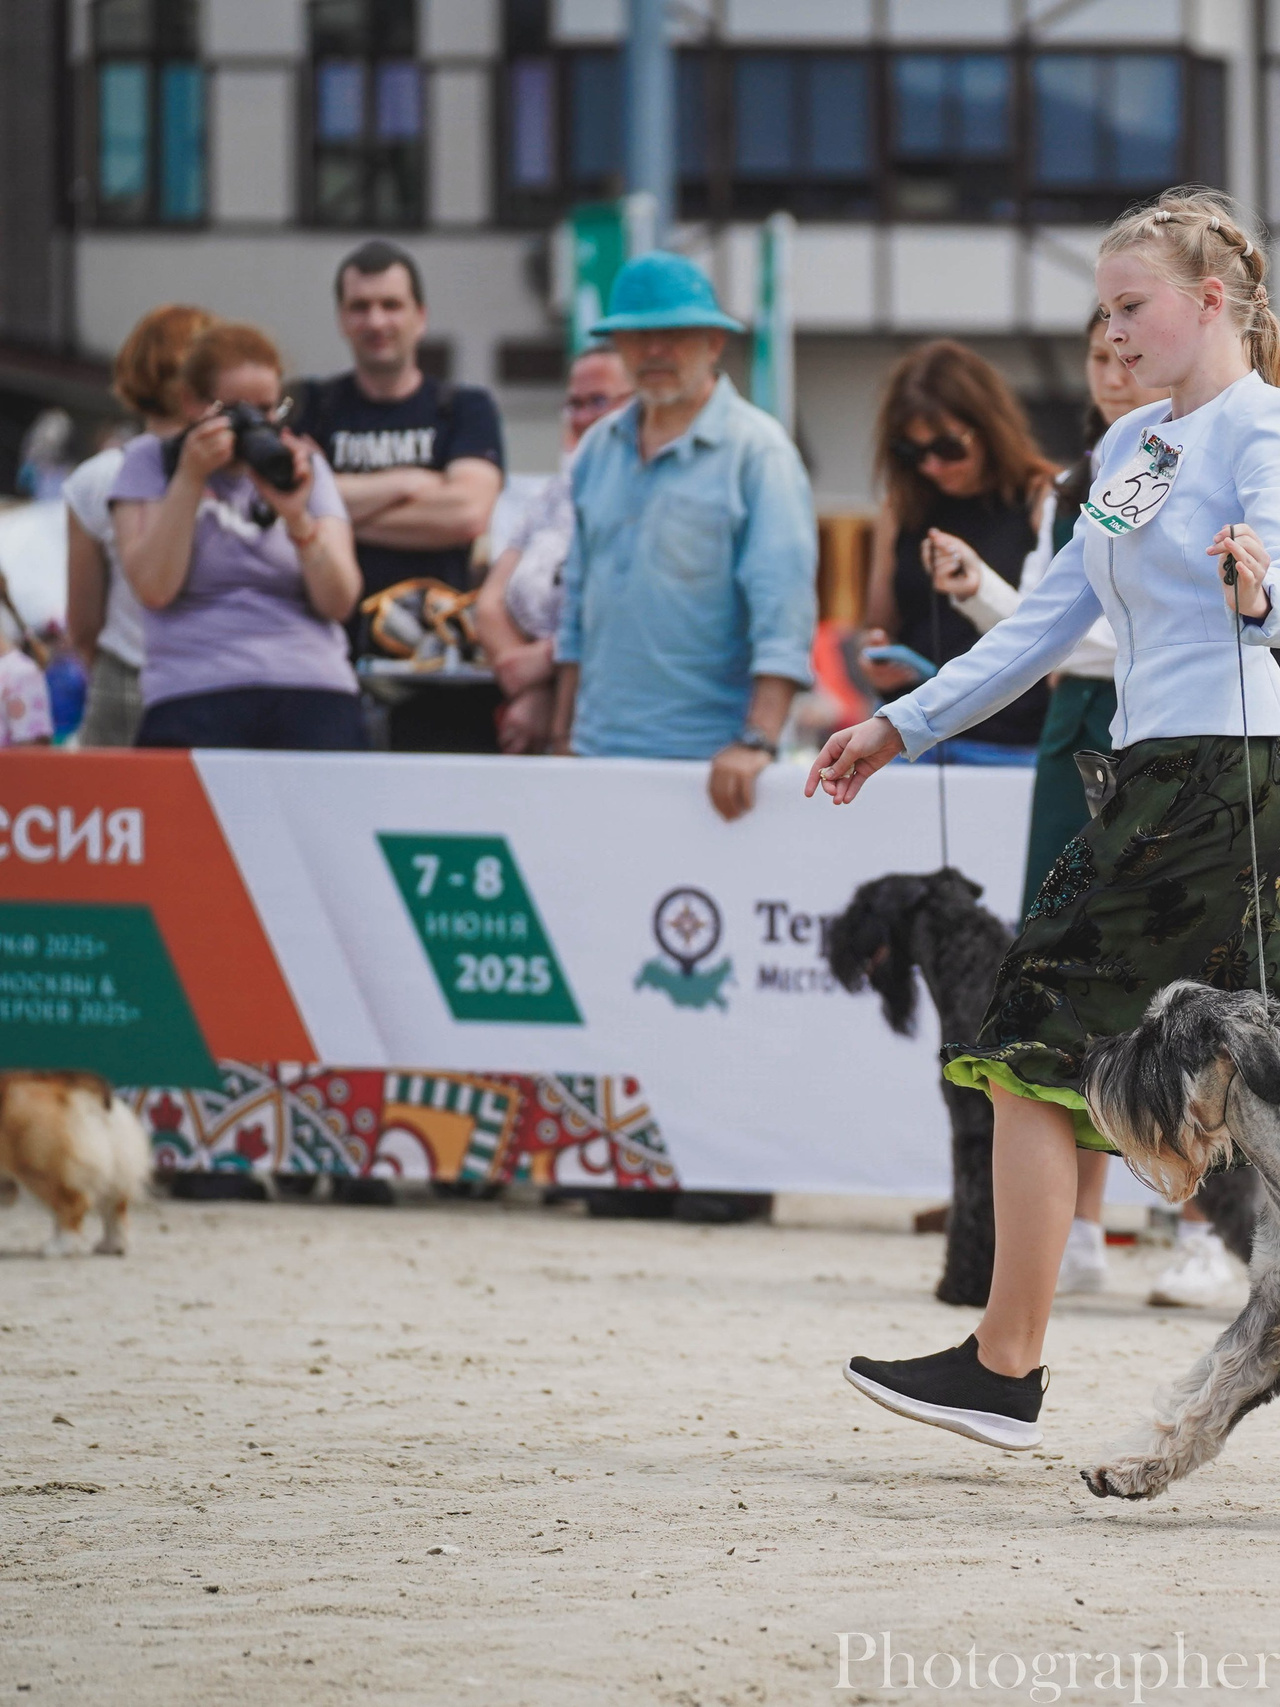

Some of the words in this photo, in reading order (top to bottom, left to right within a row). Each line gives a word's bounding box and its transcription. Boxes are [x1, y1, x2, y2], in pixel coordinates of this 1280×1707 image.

[1102, 471, 1170, 523] 52
[0, 804, 145, 864] СИЯ
[411, 853, 440, 898] 7
[474, 855, 505, 899] 8
[455, 953, 552, 995] 2025
